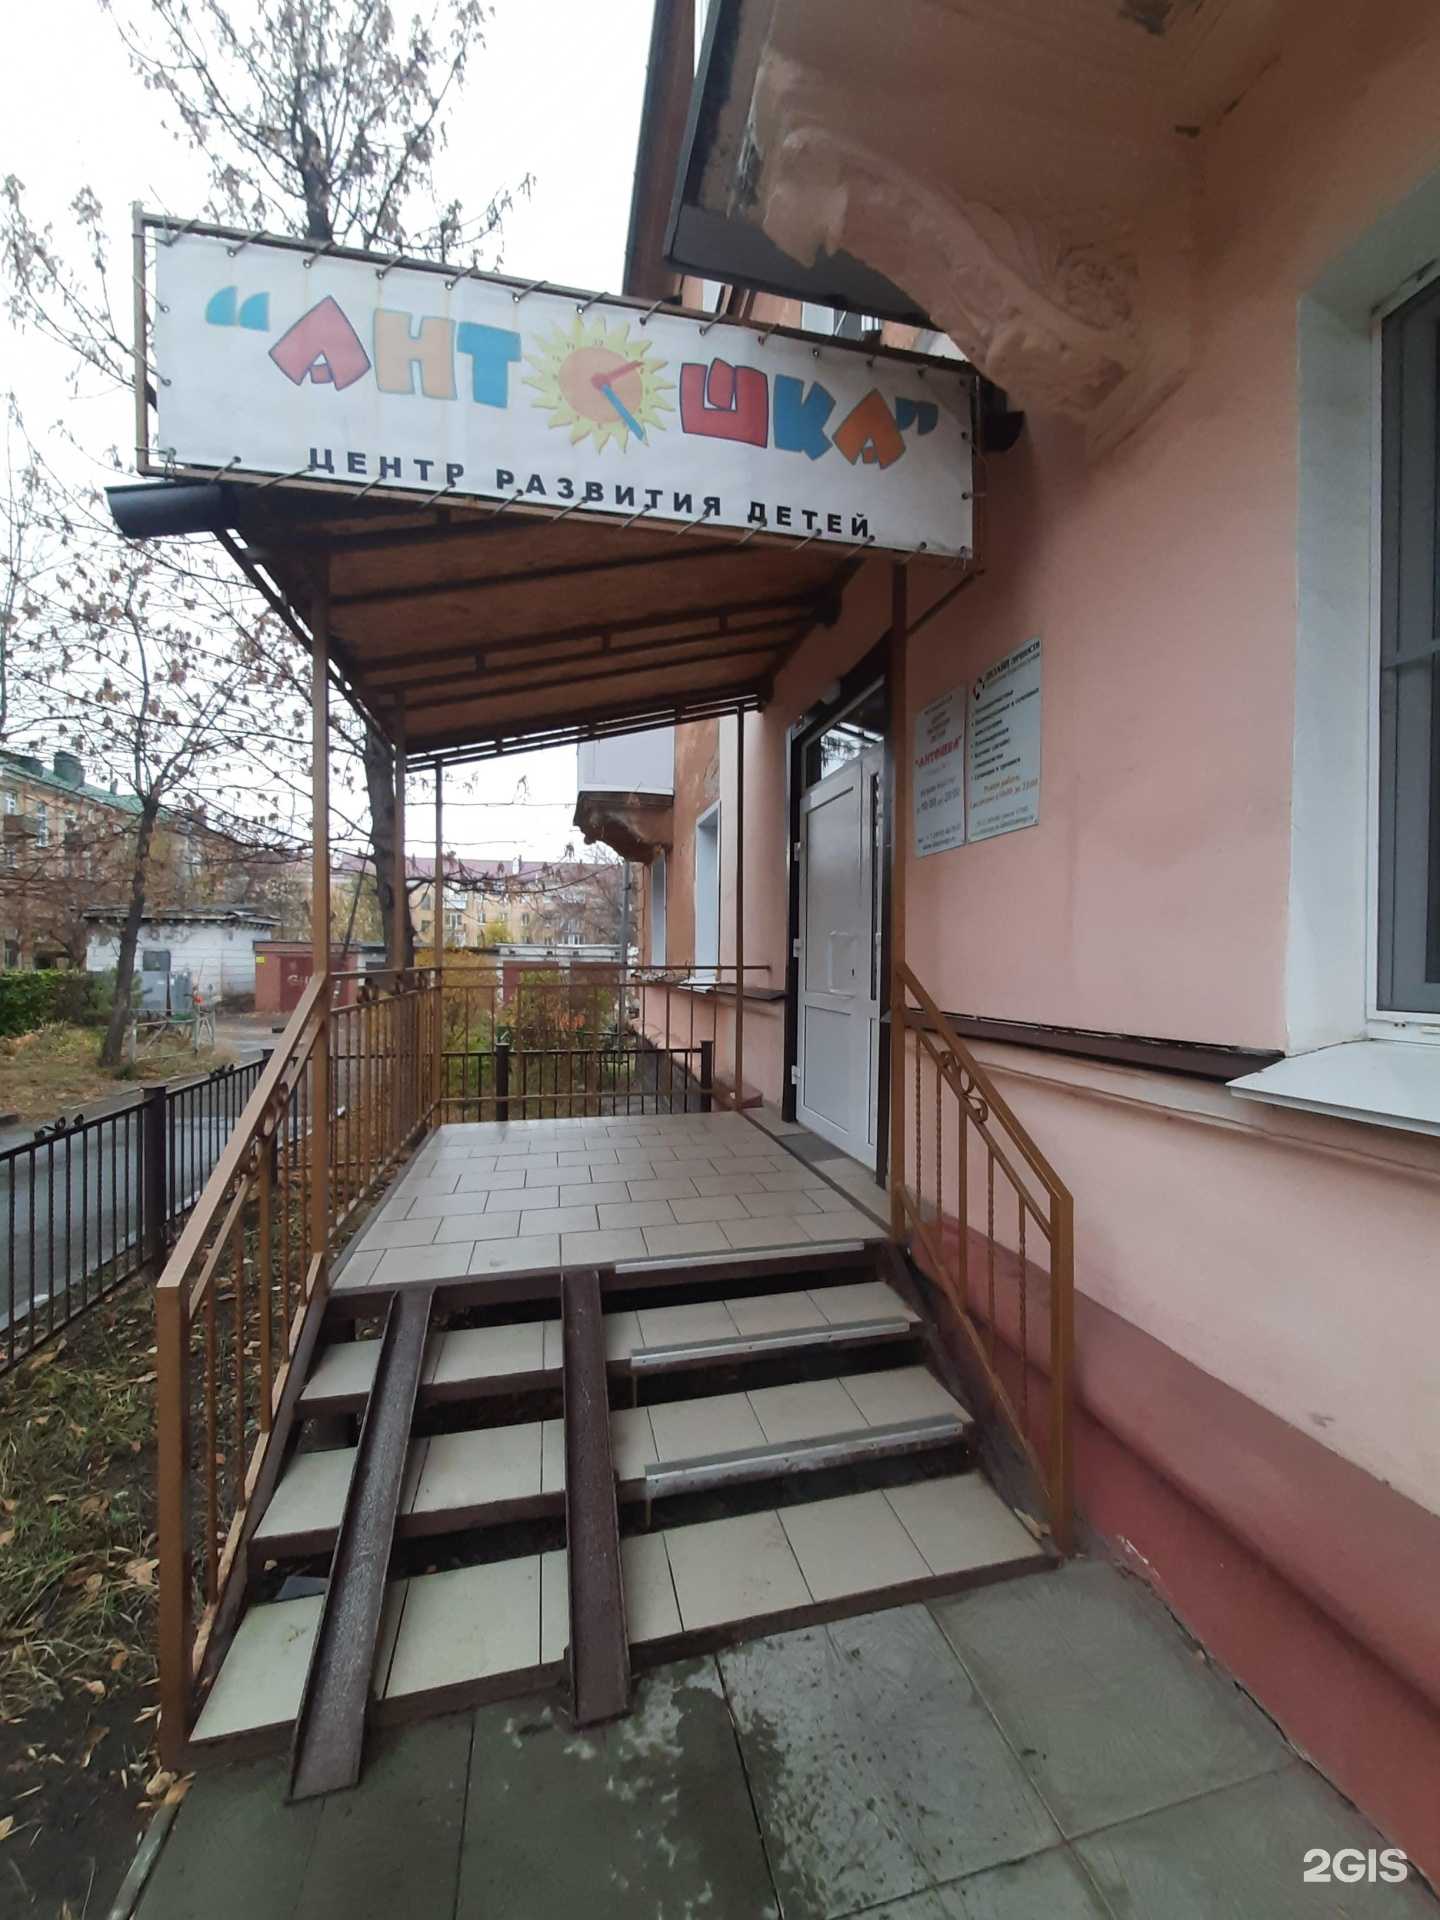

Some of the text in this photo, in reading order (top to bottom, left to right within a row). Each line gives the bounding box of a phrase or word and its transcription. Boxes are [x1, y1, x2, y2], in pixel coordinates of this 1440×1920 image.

[309, 447, 870, 539] ЦЕНТР РАЗВИТИЯ ДЕТЕЙ
